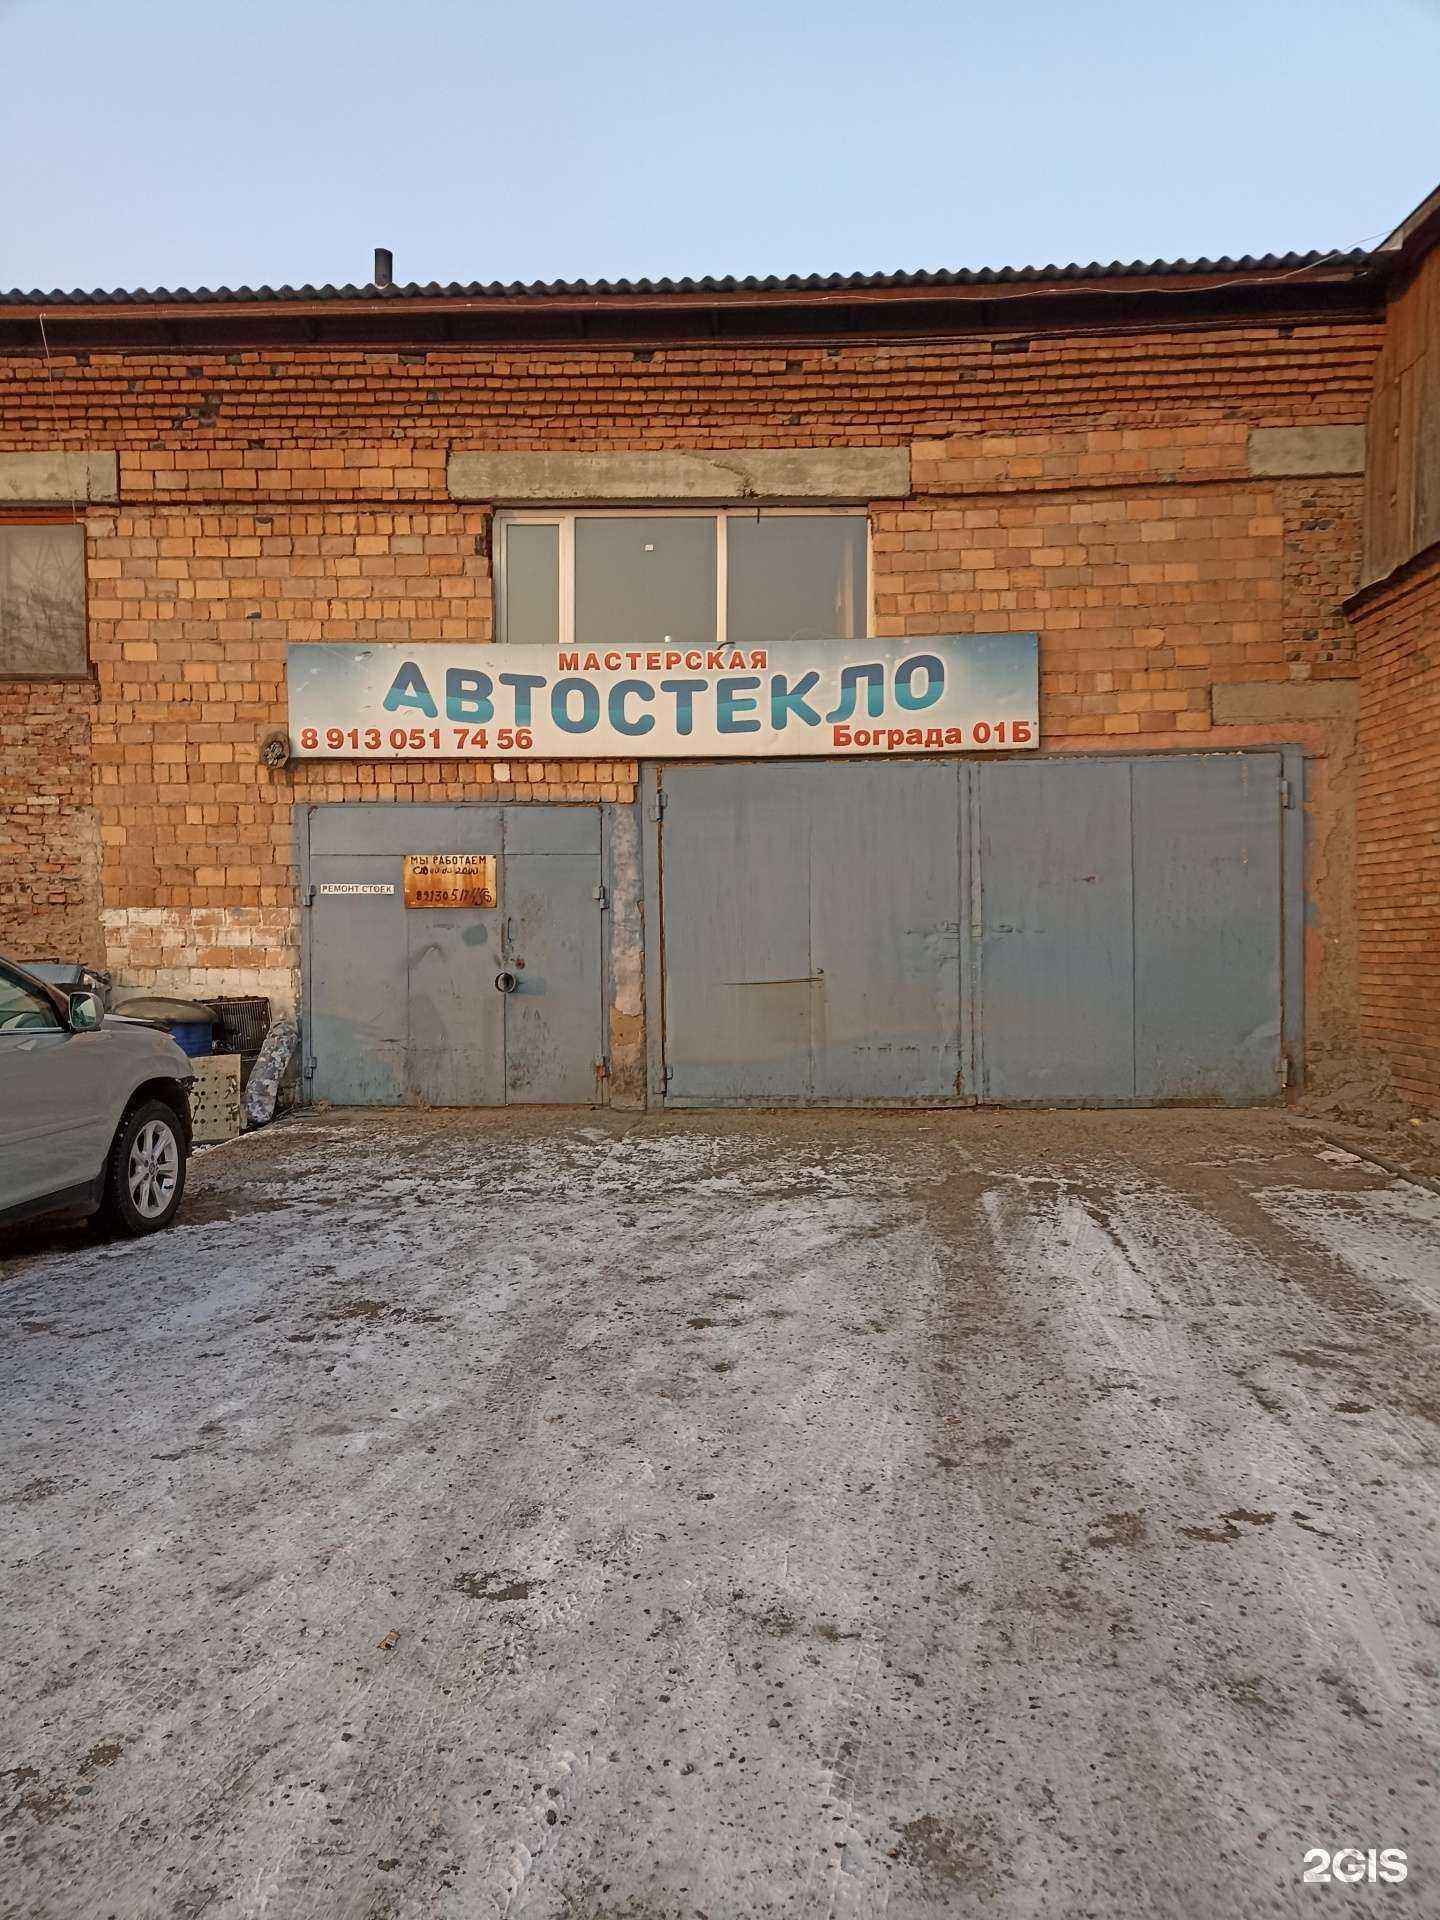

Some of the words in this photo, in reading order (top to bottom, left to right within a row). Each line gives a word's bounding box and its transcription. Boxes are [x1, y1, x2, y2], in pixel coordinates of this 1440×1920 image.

[557, 650, 768, 671] МАСТЕРСКАЯ
[382, 654, 946, 736] АВТОСТЕКЛО
[300, 728, 319, 750] 8
[326, 728, 382, 750] 913
[389, 728, 442, 750] 051
[453, 728, 489, 750] 74
[497, 728, 533, 750] 56
[832, 724, 963, 749] Бограда
[972, 721, 1032, 744] 01Б
[410, 856, 428, 865] МЫ
[433, 856, 487, 865] РАБОТАЕМ
[322, 885, 359, 893] РЕМОНТ
[361, 885, 392, 893] СТОЕК
